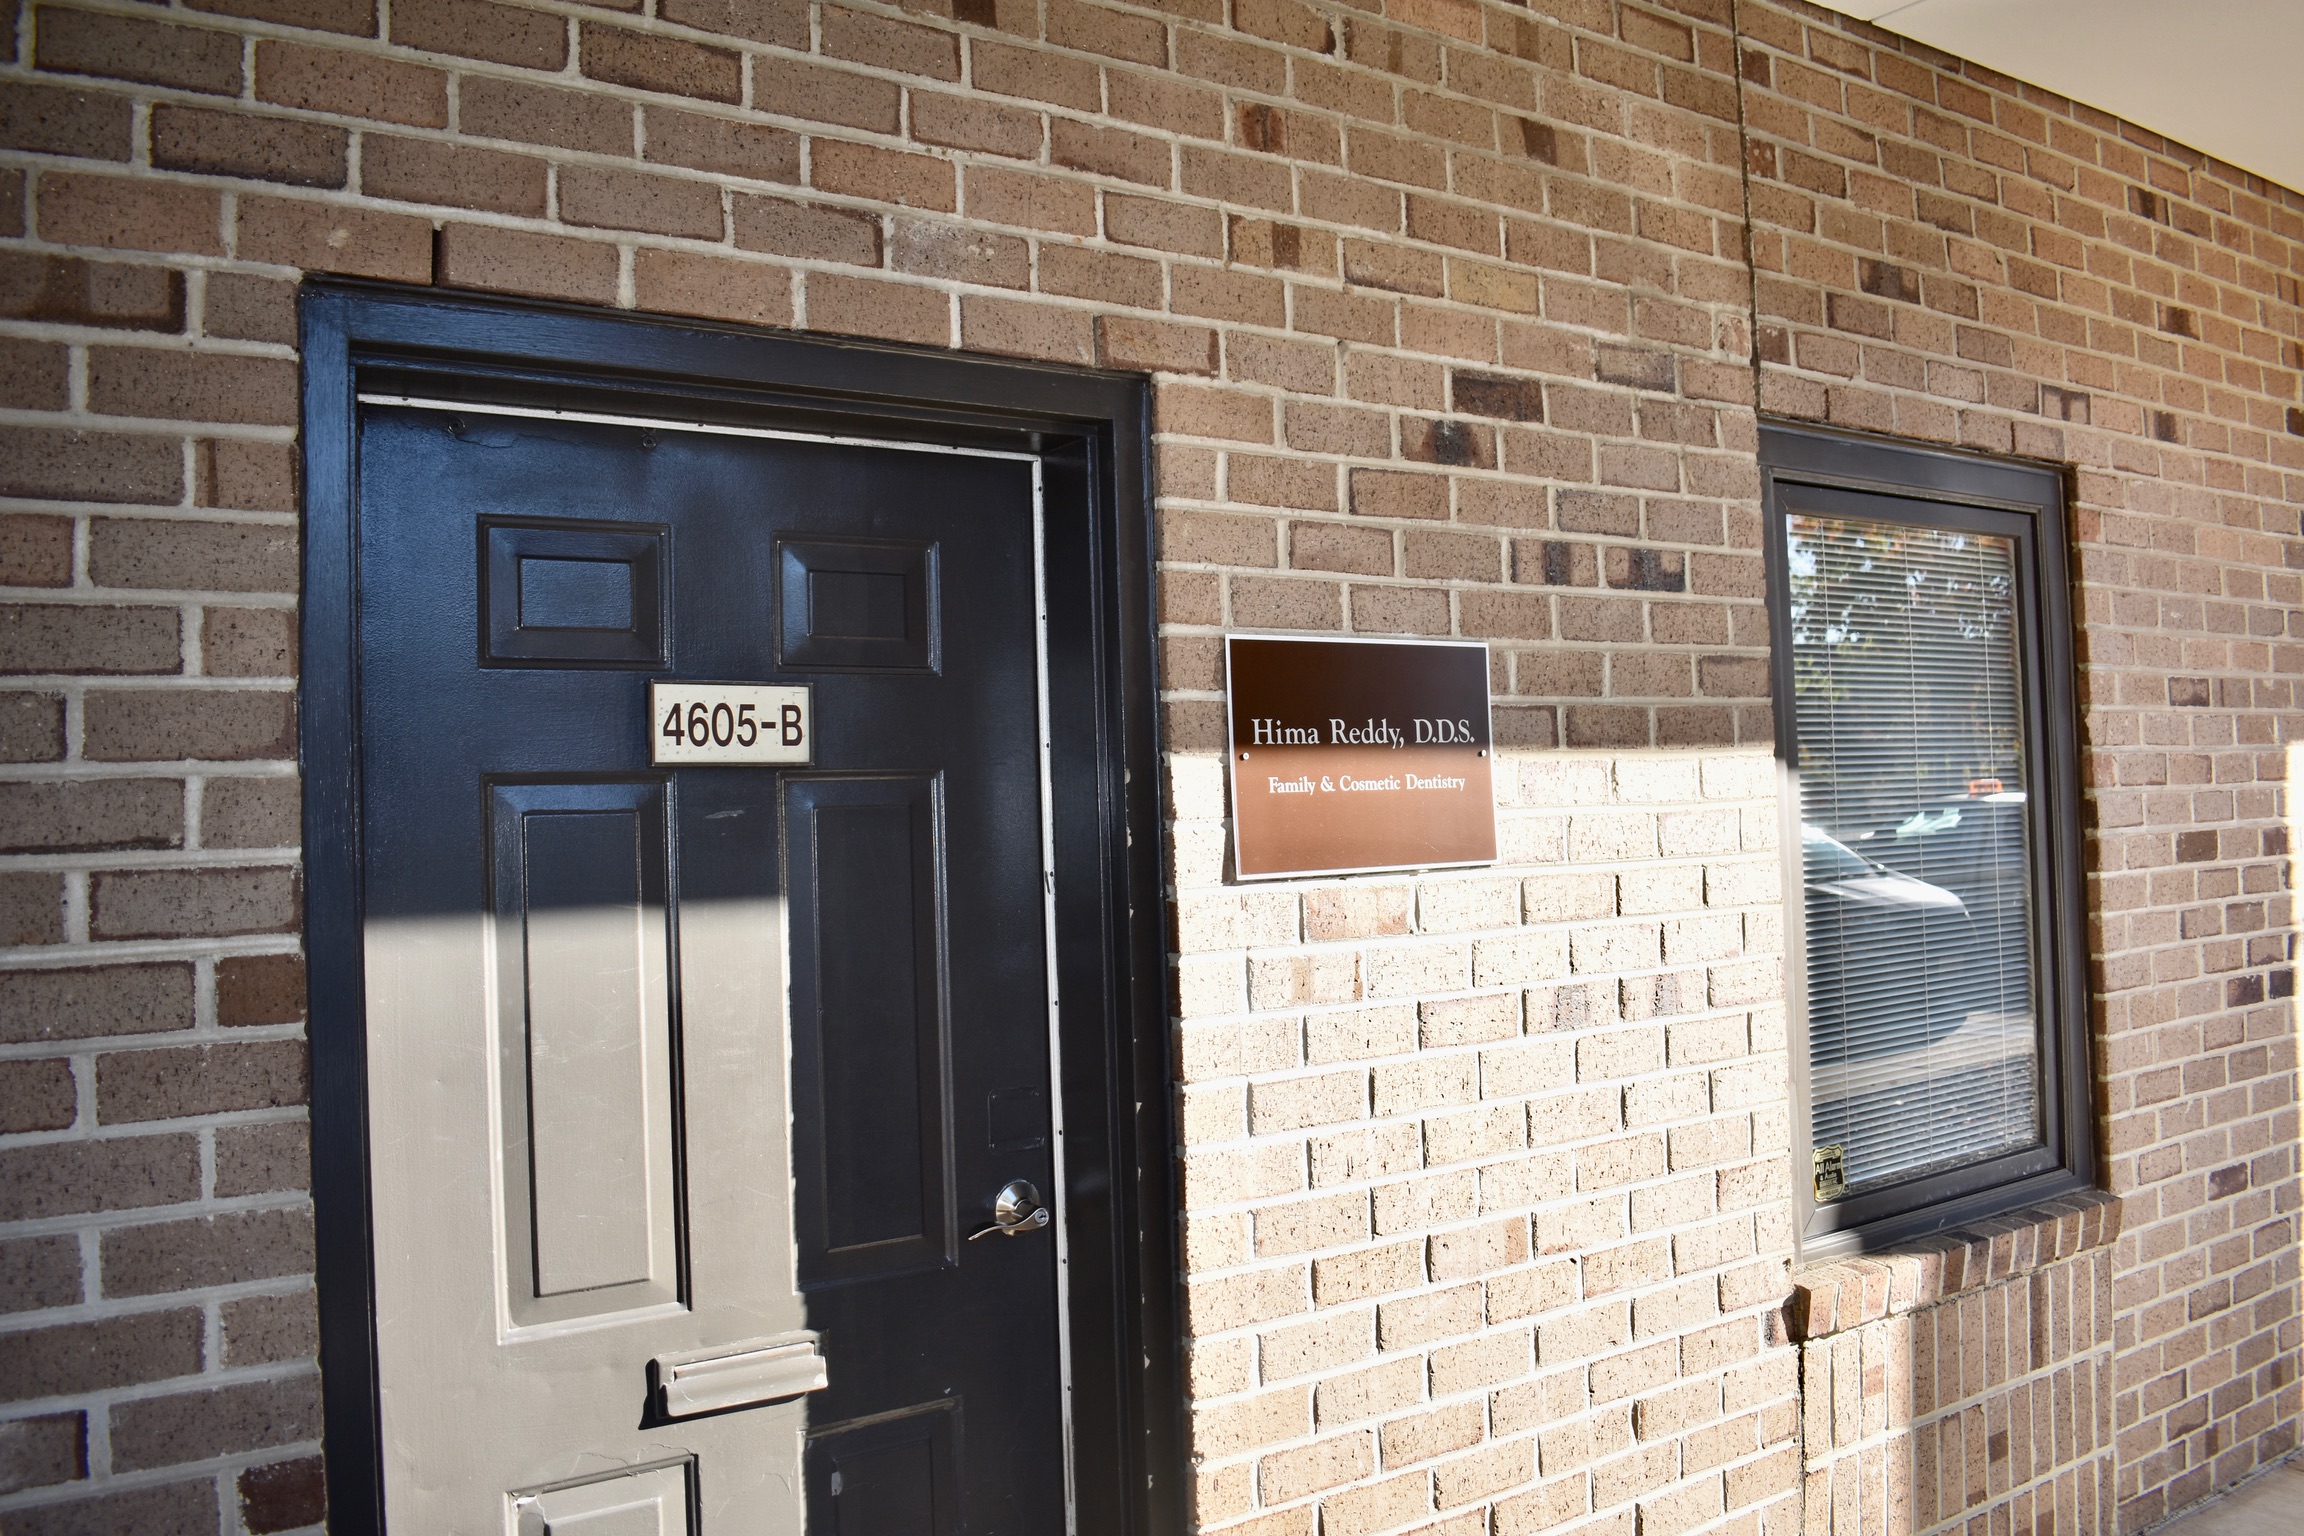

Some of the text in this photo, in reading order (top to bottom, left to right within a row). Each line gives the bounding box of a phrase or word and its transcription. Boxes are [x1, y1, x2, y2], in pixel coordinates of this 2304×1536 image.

[663, 702, 803, 747] 4605-B
[1251, 718, 1475, 749] Hima Reddy, D.D.S.
[1268, 773, 1465, 796] Family & Cosmetic Dentistry
[1815, 1162, 1825, 1175] All
